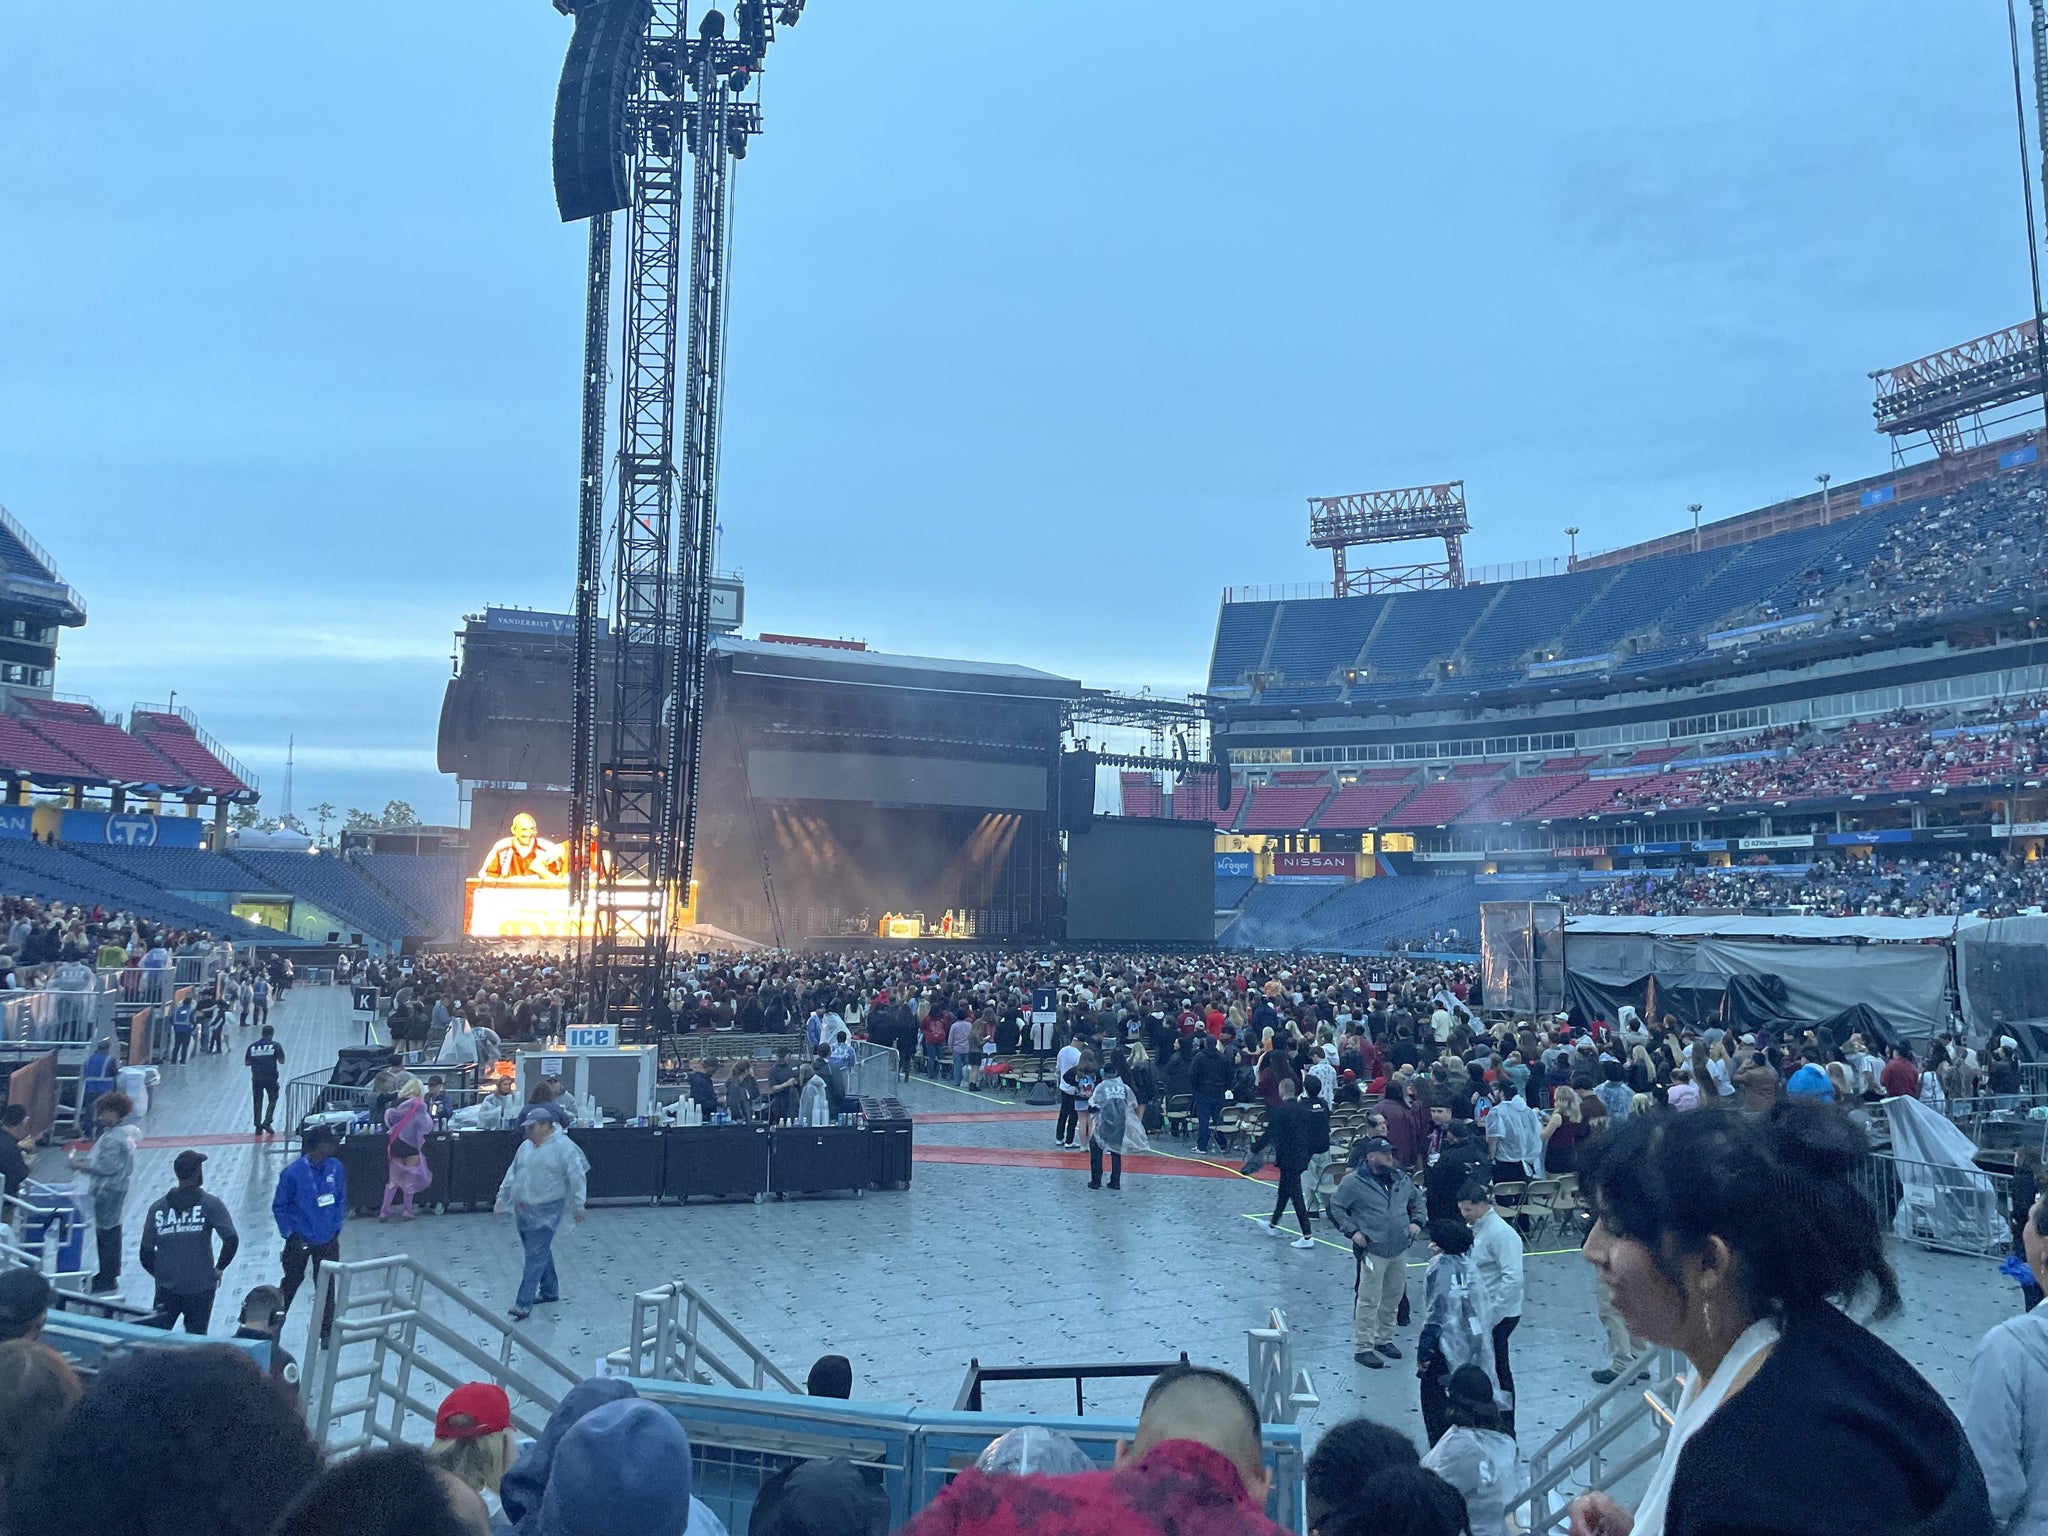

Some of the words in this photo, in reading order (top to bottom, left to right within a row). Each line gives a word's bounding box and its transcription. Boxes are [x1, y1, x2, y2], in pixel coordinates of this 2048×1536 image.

[497, 616, 550, 628] VANDERBILT
[1217, 856, 1249, 875] Kroger
[1283, 857, 1346, 867] NISSAN
[700, 956, 707, 964] D
[1042, 953, 1048, 961] C
[403, 959, 410, 967] E
[1372, 973, 1379, 982] H
[359, 994, 371, 1009] K
[1040, 996, 1049, 1010] J
[175, 1224, 204, 1233] Services
